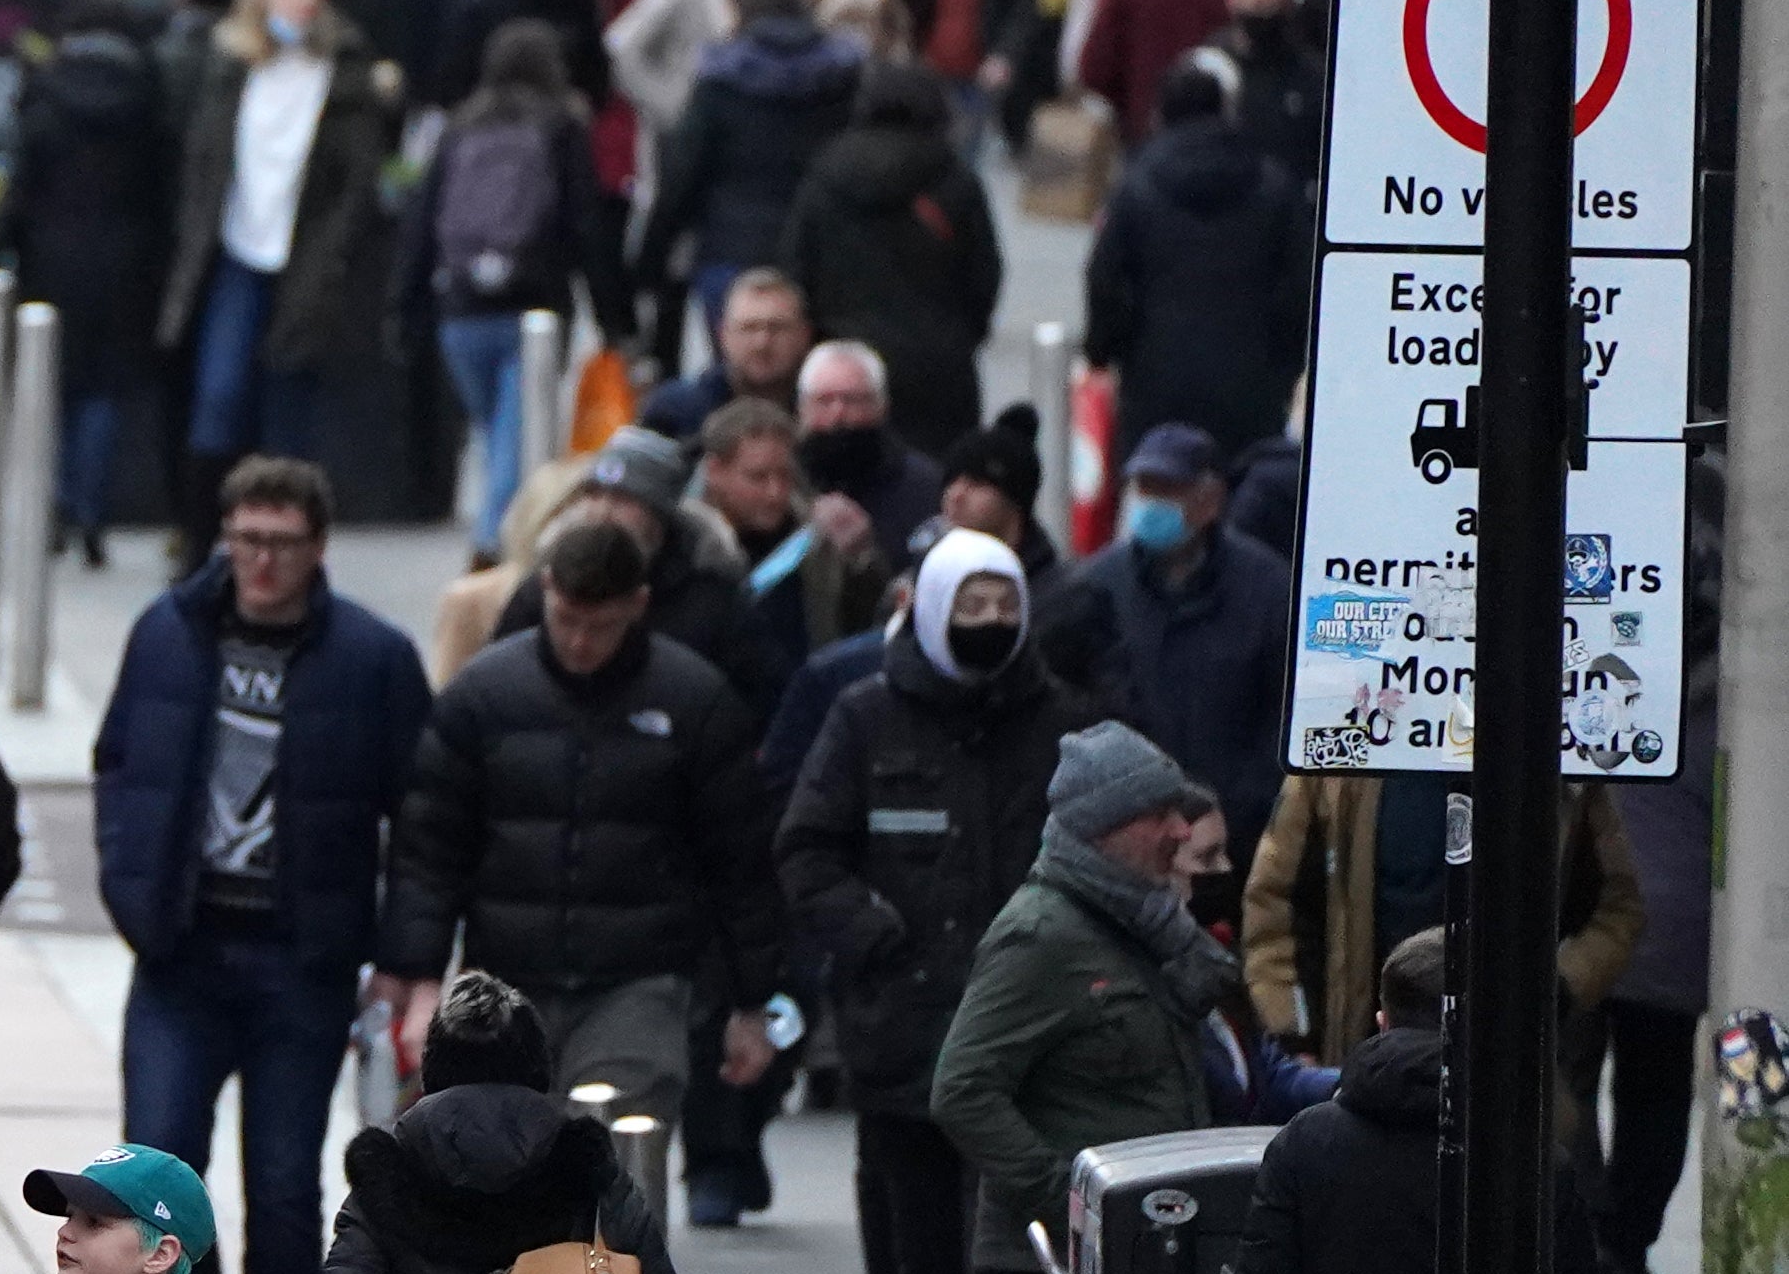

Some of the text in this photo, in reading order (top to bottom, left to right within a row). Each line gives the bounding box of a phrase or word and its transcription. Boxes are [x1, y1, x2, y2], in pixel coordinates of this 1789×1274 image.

[1384, 176, 1638, 219] No vles
[1391, 273, 1621, 314] Exce or
[1388, 326, 1480, 365] load
